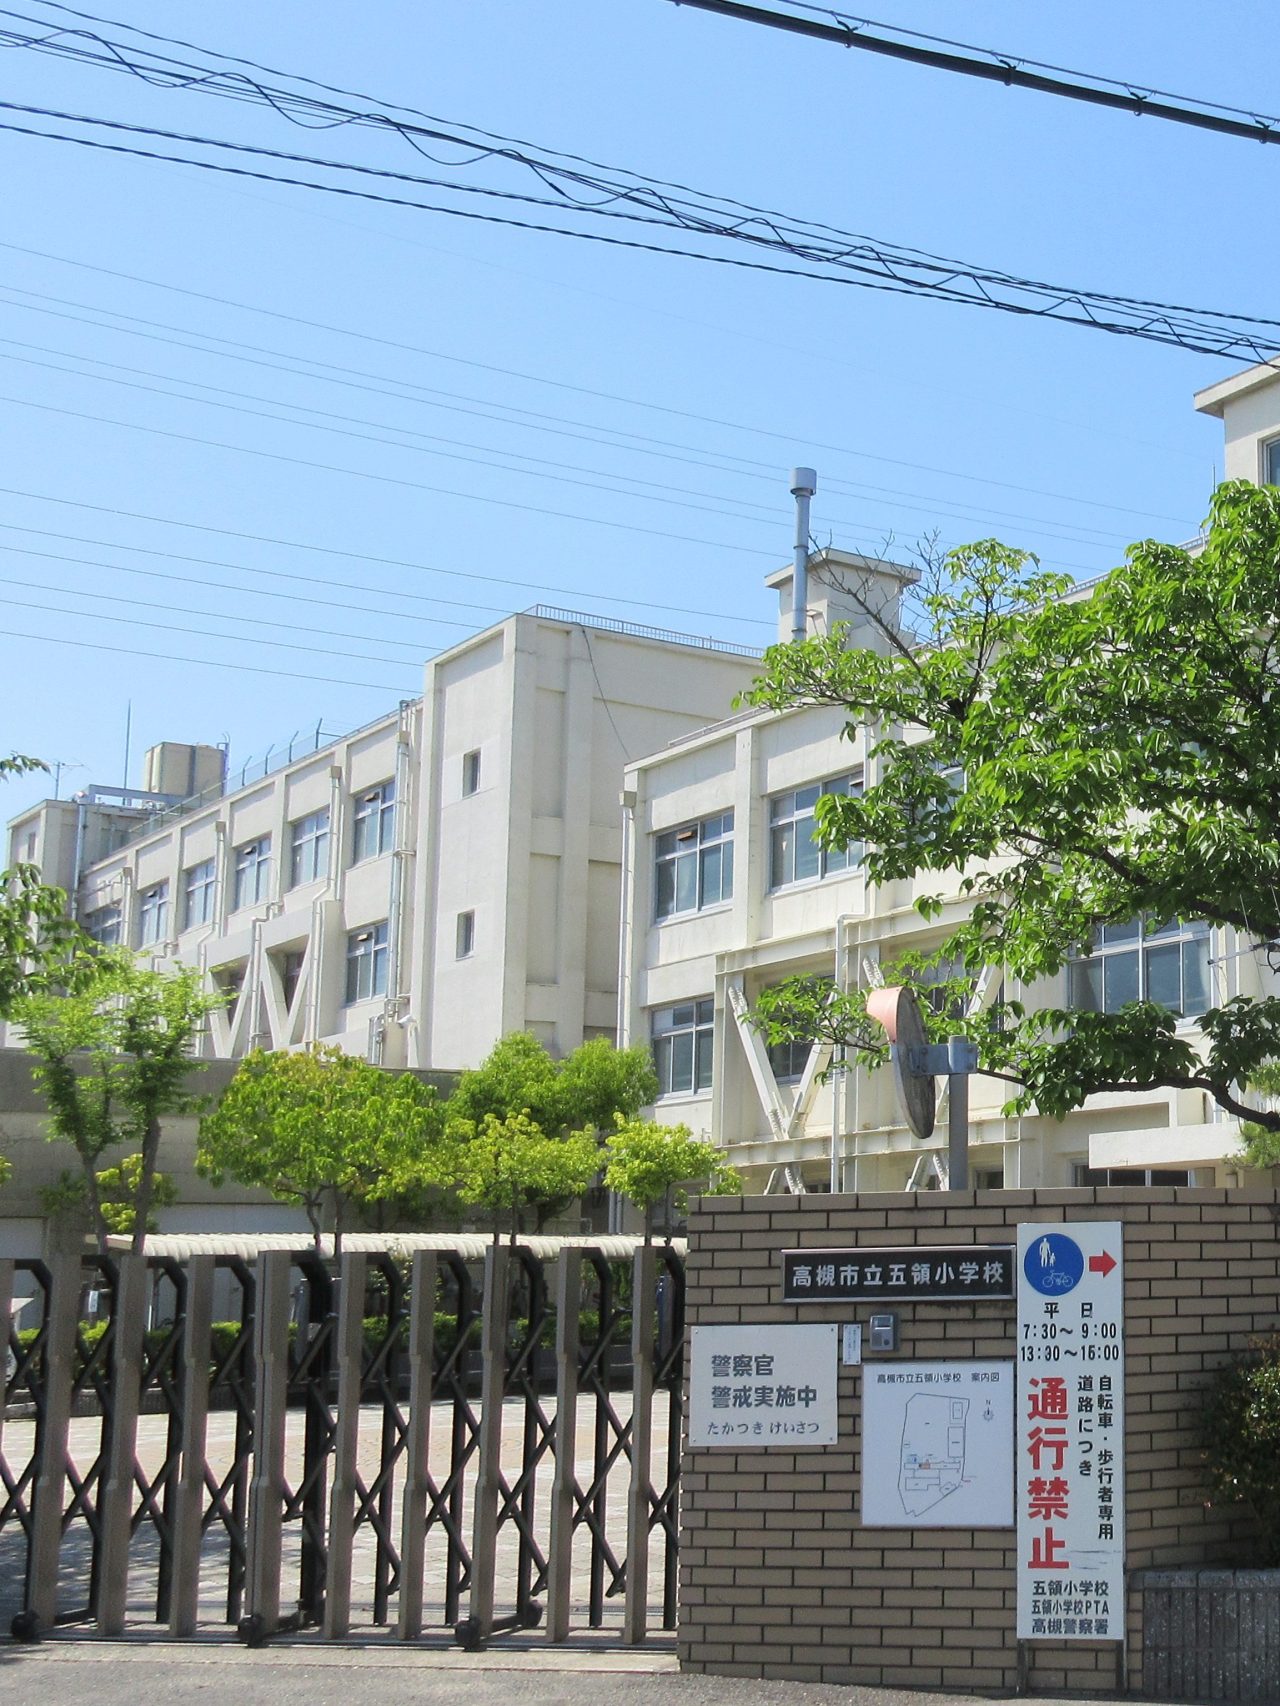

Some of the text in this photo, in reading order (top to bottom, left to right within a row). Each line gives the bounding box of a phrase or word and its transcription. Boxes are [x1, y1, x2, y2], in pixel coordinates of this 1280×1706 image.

[792, 1261, 1004, 1287] 高槻市立五領小学校
[1044, 1302, 1093, 1319] 平日
[711, 1354, 775, 1377] 警察官
[711, 1385, 817, 1409] 警戒実施中
[1077, 1375, 1094, 1476] 道路につき
[1097, 1375, 1114, 1540] 自転車・歩行者専用
[1027, 1377, 1069, 1569] 通行禁止
[1032, 1580, 1109, 1596] 五領小学校
[1031, 1599, 1109, 1615] 五領小学校PTA
[1032, 1618, 1109, 1634] 高槻警察署
